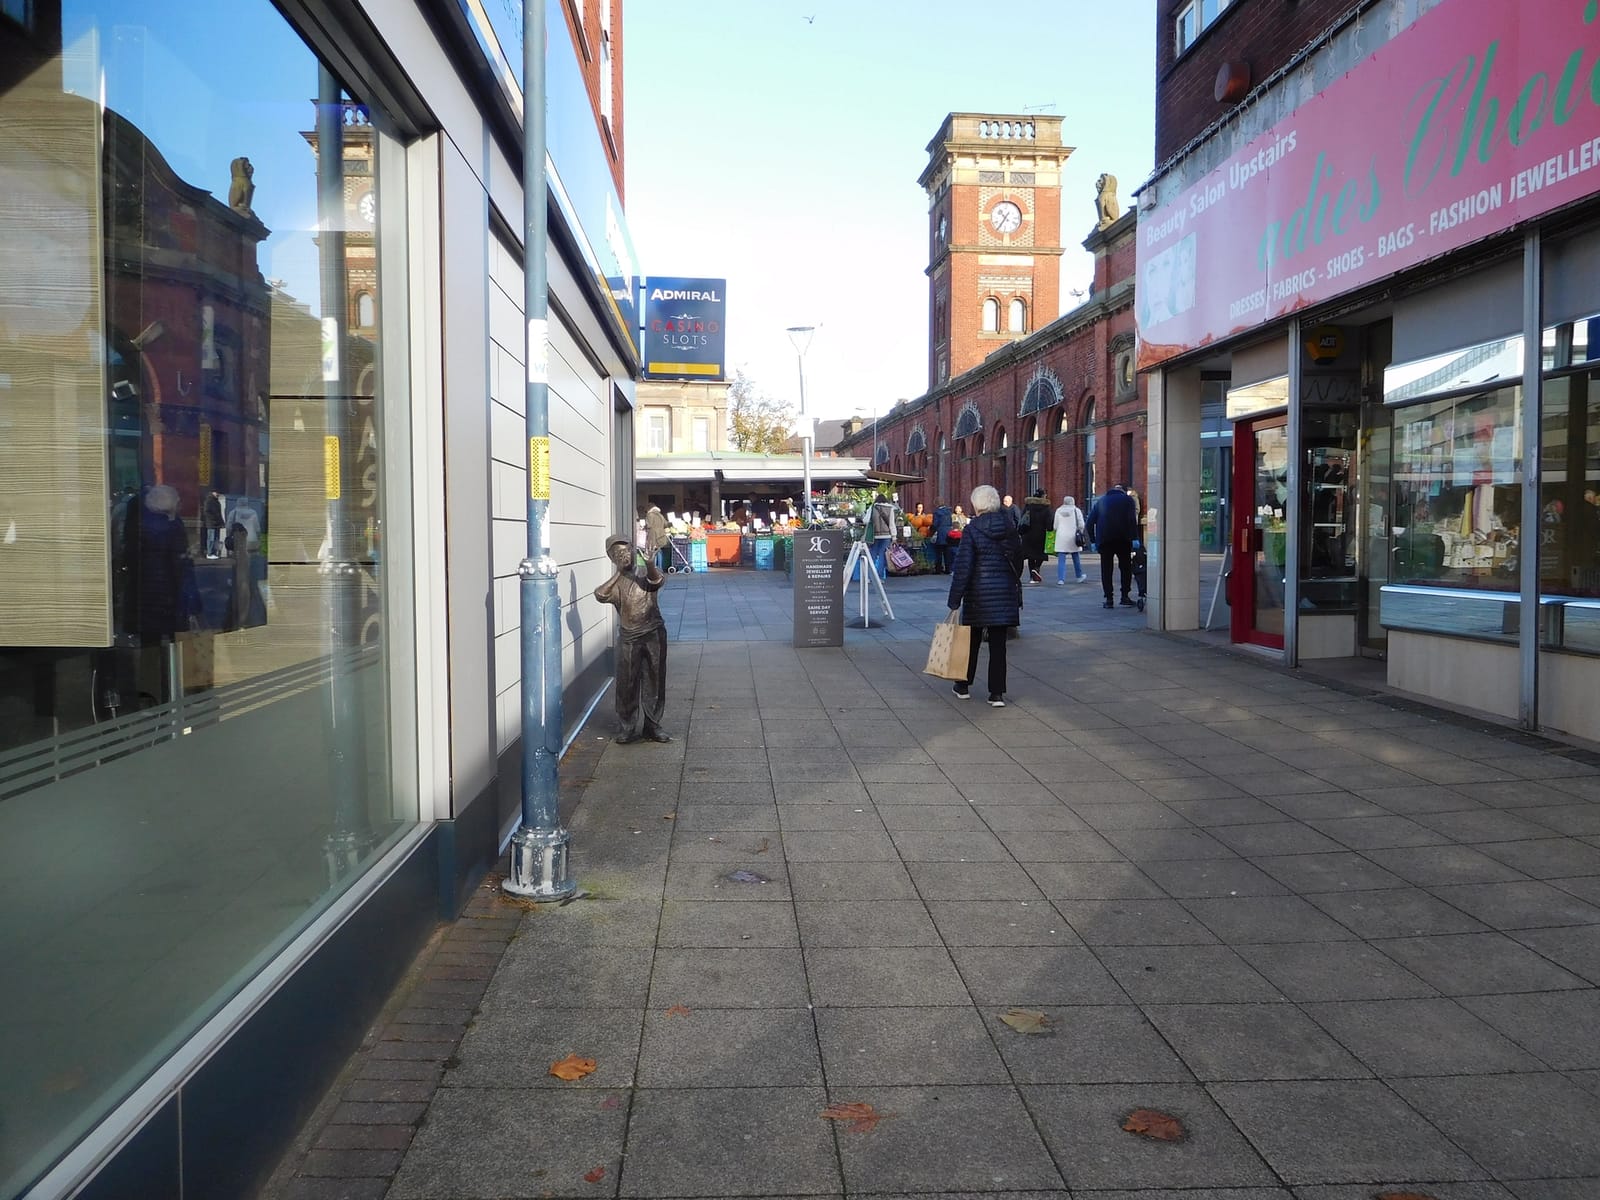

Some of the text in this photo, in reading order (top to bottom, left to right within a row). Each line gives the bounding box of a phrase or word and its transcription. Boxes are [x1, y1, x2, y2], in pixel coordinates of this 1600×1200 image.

[1146, 130, 1297, 247] Beauty Salon Upstairs
[1230, 288, 1266, 320] DRESSES
[1273, 267, 1316, 301] FABRICS
[1326, 245, 1365, 280] SHOES
[1377, 223, 1415, 258] BAGS
[1429, 182, 1503, 236] FASHION
[650, 288, 721, 302] ADMIRAL
[651, 320, 720, 333] CASINO
[663, 334, 708, 345] SLOTS
